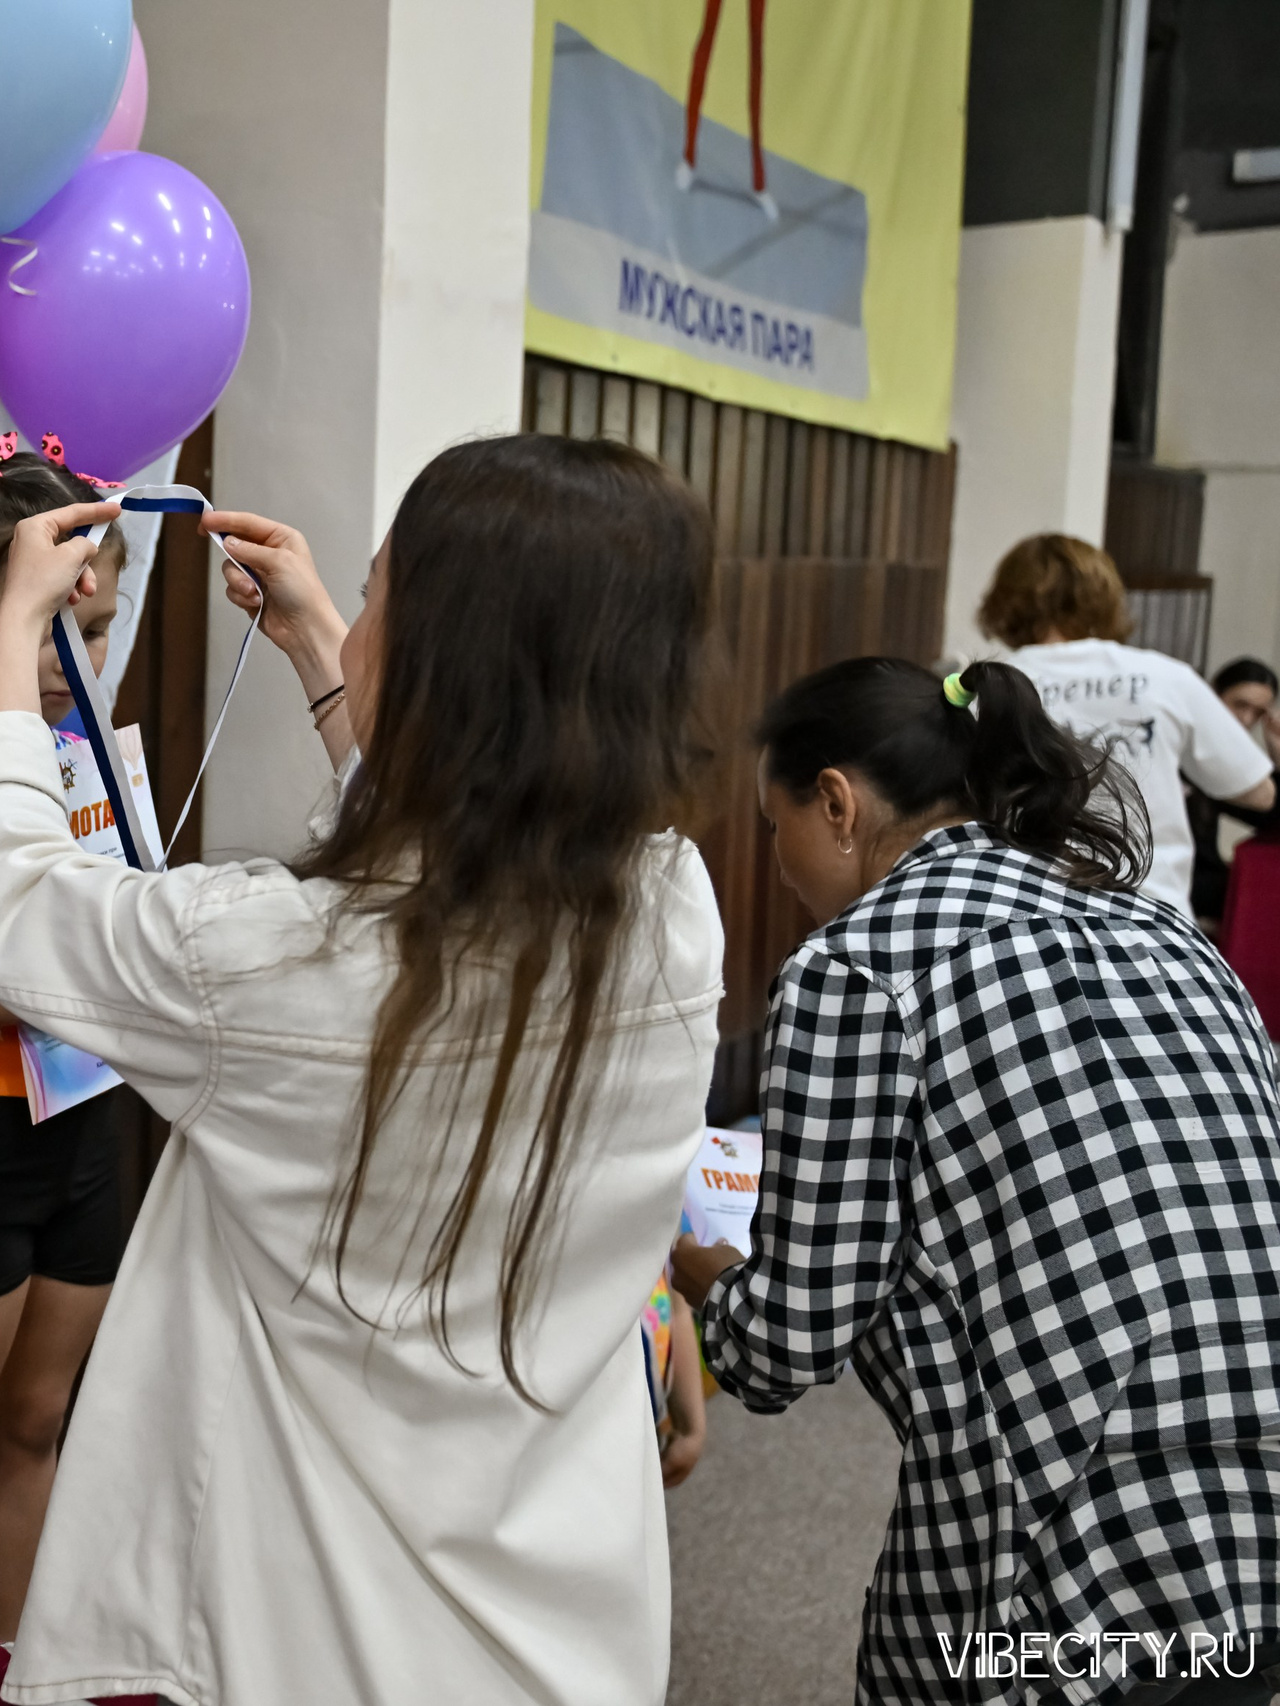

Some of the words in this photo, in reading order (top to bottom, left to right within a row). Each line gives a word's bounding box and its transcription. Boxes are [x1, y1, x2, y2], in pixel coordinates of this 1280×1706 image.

[618, 257, 746, 350] МУЖСКАЯ
[750, 310, 816, 372] ПАРА
[1042, 674, 1148, 706] ренер
[70, 798, 115, 840] МОТА
